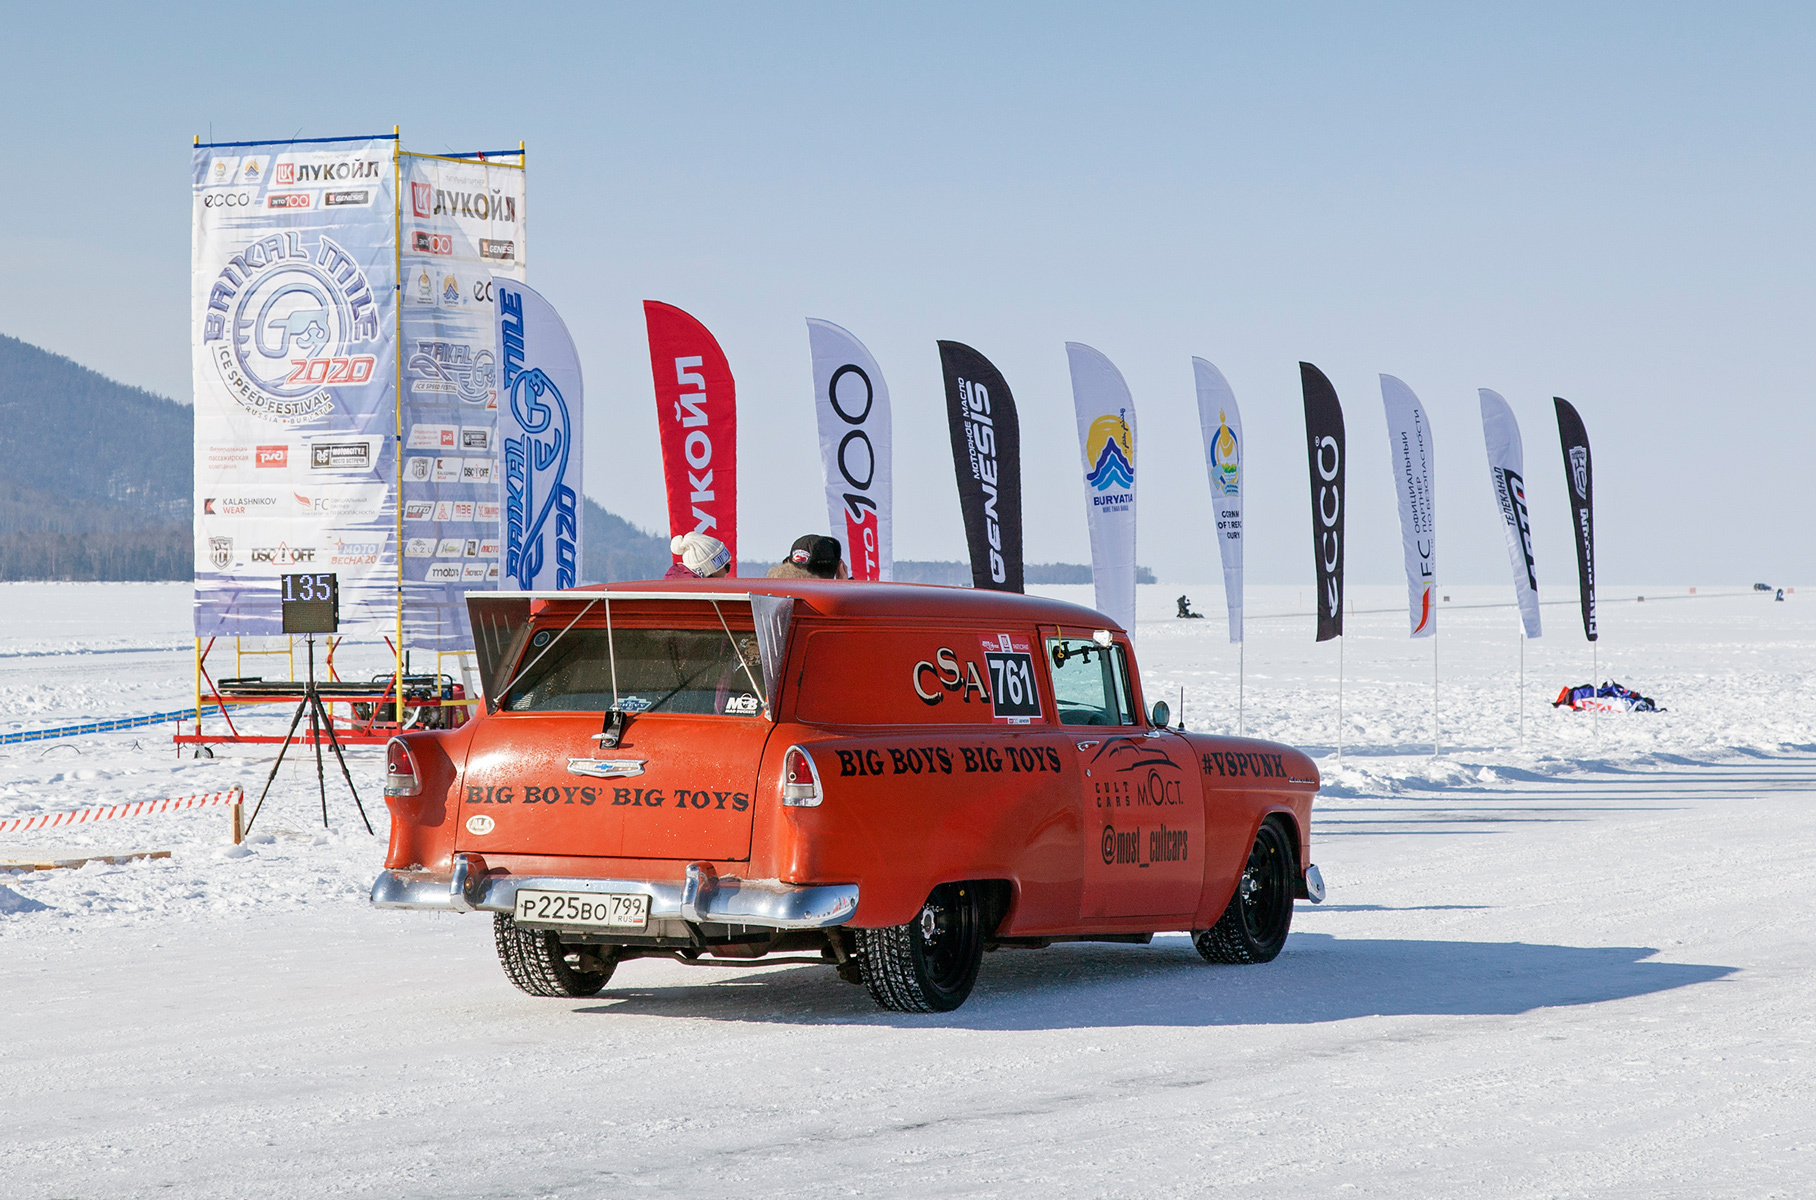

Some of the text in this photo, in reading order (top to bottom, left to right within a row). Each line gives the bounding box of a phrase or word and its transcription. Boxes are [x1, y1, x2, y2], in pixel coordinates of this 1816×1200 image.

[296, 158, 379, 182] ЛУКОЙЛ
[434, 188, 515, 222] ЛУКОЙЛ
[204, 232, 378, 345] BAIKAL MILE
[473, 280, 493, 303] ec
[218, 345, 330, 415] ICE SPEED FESTIVAL
[286, 356, 375, 384] 2020
[245, 405, 278, 424] RUSSIA
[500, 288, 524, 578] BAIKAL MILE
[957, 377, 980, 479] МОТОРНОЕ МАСЛО
[675, 355, 717, 534] УКОЙЛ
[1414, 409, 1431, 511] БЕЗОПАСНОСТИ
[829, 364, 880, 581] ТО 100
[966, 380, 1006, 584] GENESIS
[1401, 431, 1421, 534] ОФИЦИАЛЬНЫЙ
[223, 498, 276, 506] KALASHNIKOV
[1416, 476, 1427, 532] ПАРТНЕР
[1493, 466, 1516, 527] ТЕЛЕКАНАЛ
[556, 483, 576, 590] 2020
[1417, 539, 1432, 577] FC
[282, 574, 331, 601] 135
[990, 660, 1034, 705] 761
[835, 749, 884, 777] BIG
[959, 746, 1003, 773] BIG
[1004, 746, 1061, 774] TOYS
[465, 786, 749, 812] BIG BOYS' BIG TOYS
[1095, 781, 1128, 794] CULT
[1097, 795, 1131, 808] CARS
[1102, 823, 1188, 868] @most_cultcars
[612, 897, 643, 916] 799
[617, 915, 633, 923] RUS
